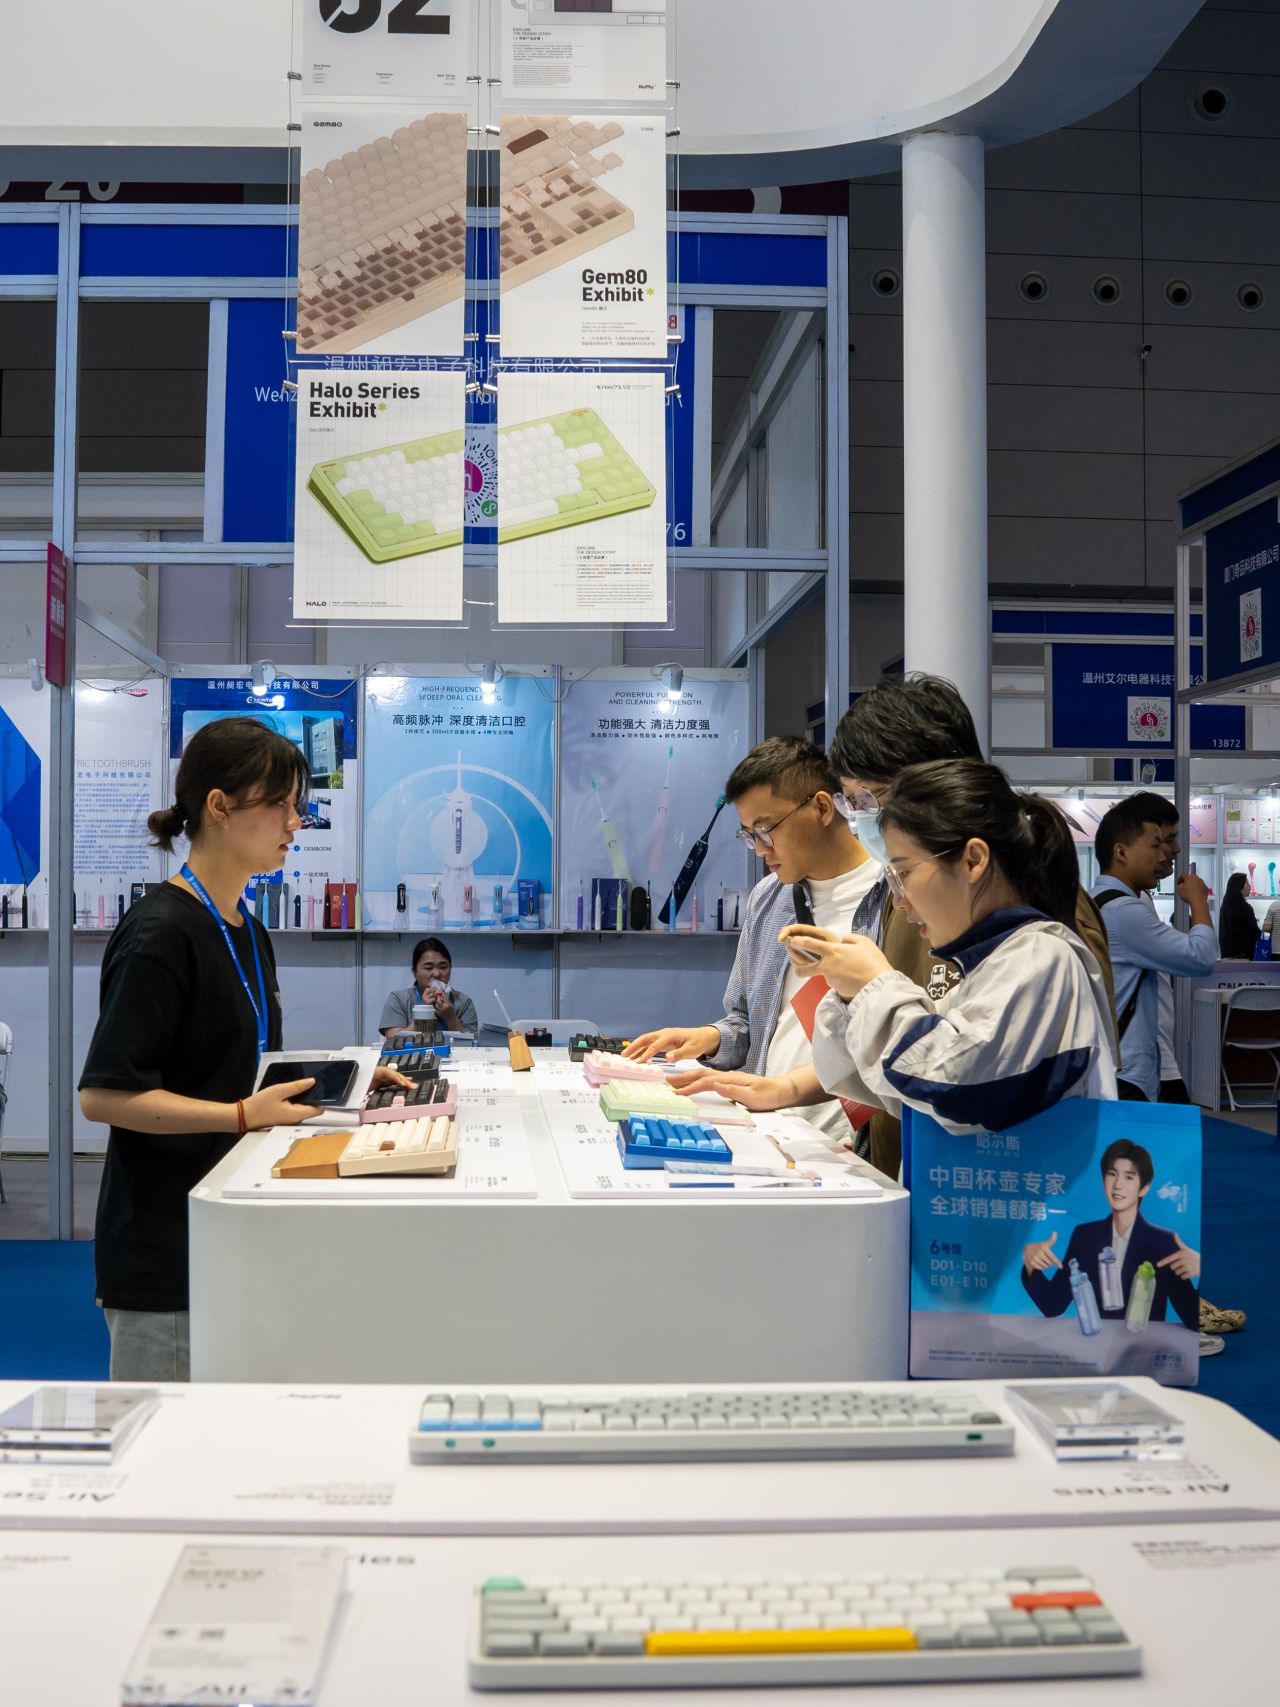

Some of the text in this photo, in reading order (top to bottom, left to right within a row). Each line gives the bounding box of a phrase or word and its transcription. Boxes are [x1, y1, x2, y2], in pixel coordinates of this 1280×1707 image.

[582, 268, 648, 285] Gem80
[582, 286, 644, 302] Exhibit
[310, 382, 420, 399] Halo Series
[310, 401, 377, 418] Exhibit
[392, 714, 526, 727] 高频脉冲 深度清洁口腔
[598, 718, 710, 730] 功能强大 清洁力度强
[93, 759, 151, 768] TOOTHBRUSH
[976, 1132, 1020, 1150] 哈尔斯
[929, 1165, 1066, 1195] 中国杯壶专家
[929, 1195, 1067, 1221] 全球销售额第一
